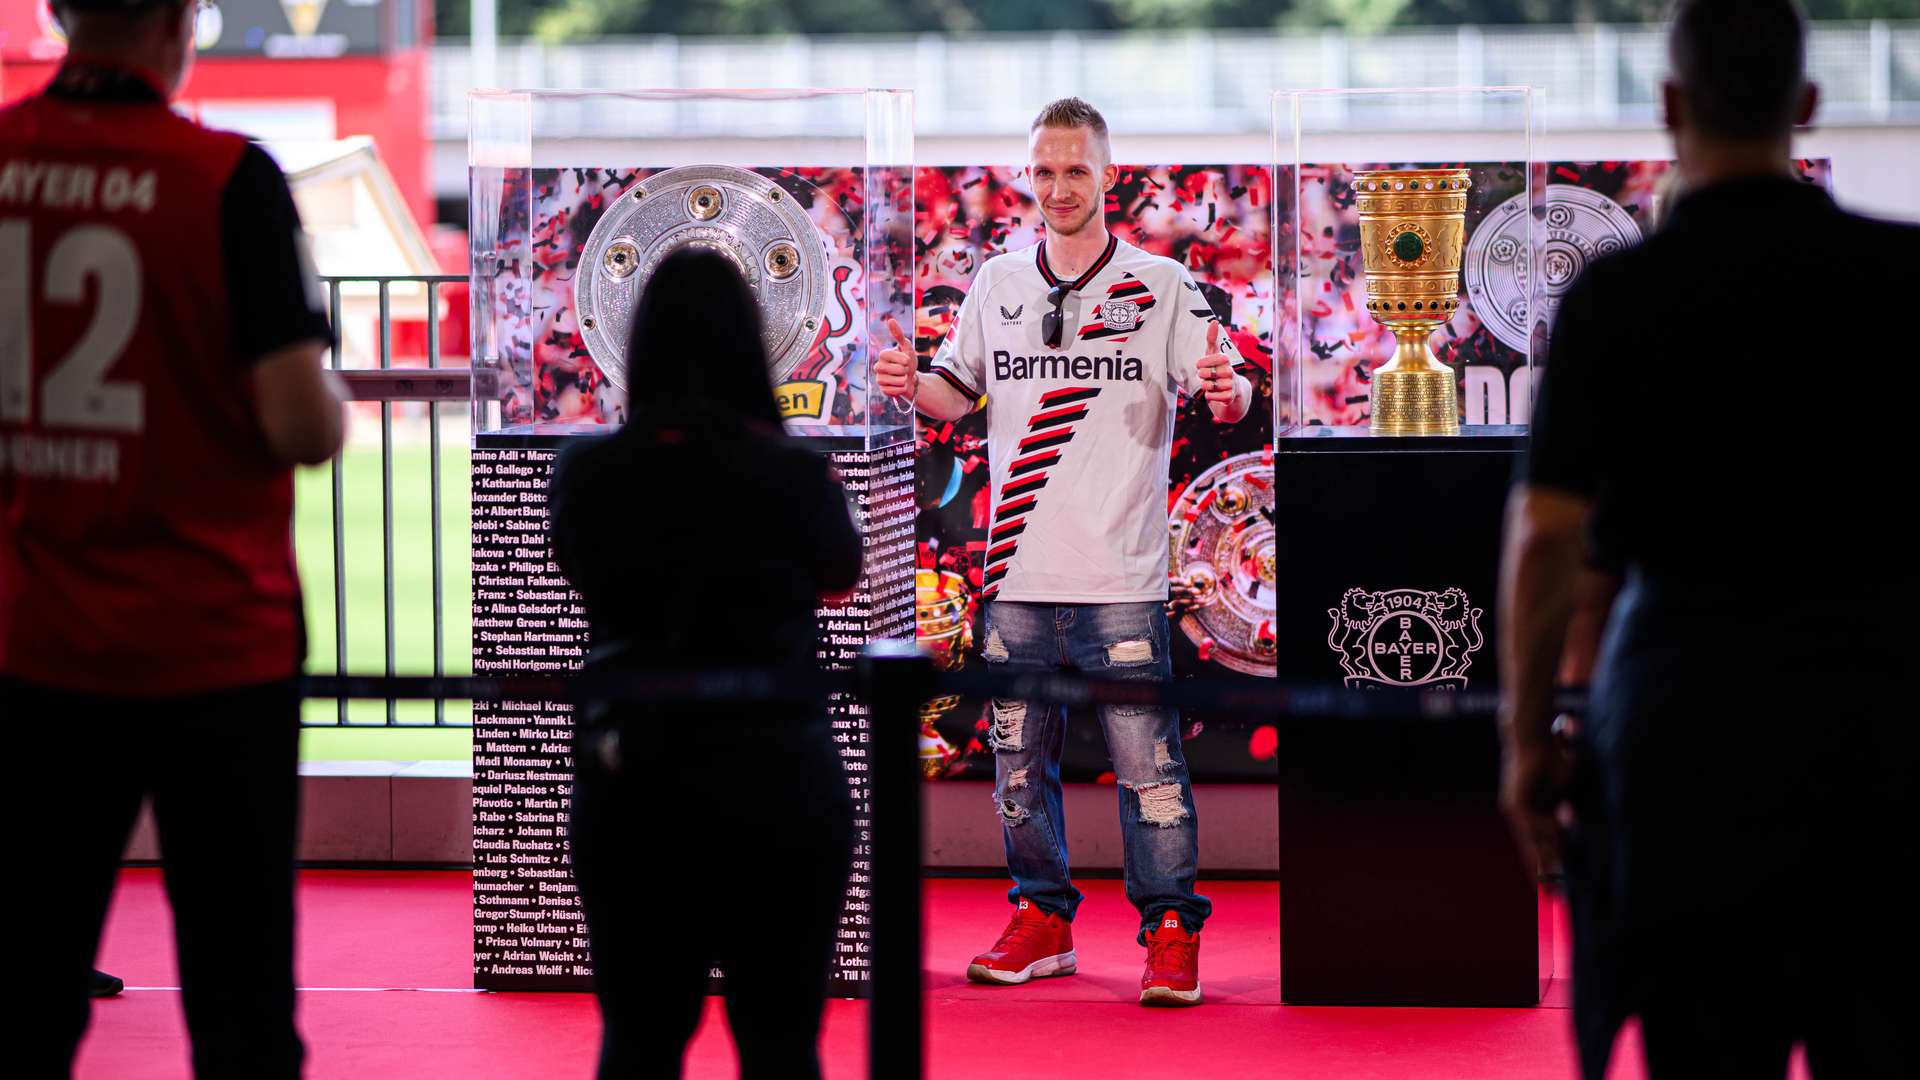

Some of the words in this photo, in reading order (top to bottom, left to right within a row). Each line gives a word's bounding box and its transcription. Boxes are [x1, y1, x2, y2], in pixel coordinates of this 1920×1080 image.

[101, 163, 158, 213] 04
[993, 349, 1143, 382] Barmenia
[472, 451, 497, 460] mine
[498, 451, 518, 460] Adli
[496, 464, 533, 476] Gallego
[481, 478, 531, 488] Katharina
[841, 481, 869, 490] obel
[490, 506, 522, 516] Albert
[505, 520, 541, 530] Sabine
[491, 534, 519, 544] Petra
[521, 534, 544, 544] Dahl
[514, 548, 545, 558] Oliver
[509, 562, 544, 573] Philipp
[478, 576, 524, 585] Christian
[478, 590, 506, 599] Franz
[516, 590, 567, 600] Sebastian
[1387, 595, 1422, 609] 1904
[491, 604, 517, 613] Alina
[518, 604, 561, 613] Gelsdorf
[516, 618, 547, 627] Green
[826, 621, 861, 630] Adrian
[480, 631, 522, 643] Stephan
[524, 632, 574, 641] Hartmann
[830, 634, 864, 645] Tobias
[495, 645, 546, 655] Sebastian
[549, 646, 582, 656] Hirsch
[1374, 642, 1437, 655] BAYER
[1398, 617, 1412, 680] BAYER
[474, 659, 511, 670] Kiyoshi
[512, 659, 561, 671] Horigome
[502, 701, 541, 710] Michael
[474, 715, 526, 724] Lackmann
[533, 715, 566, 725] Yannik
[476, 728, 510, 738] Linden
[519, 729, 549, 738] Mirko
[486, 742, 526, 752] Mattern
[838, 747, 866, 756] shua
[475, 756, 501, 766] Madi
[503, 757, 552, 768] Monamay
[487, 770, 526, 780] Dariusz
[504, 784, 547, 794] Palacios
[473, 798, 513, 807] Plavotic
[524, 799, 558, 808] Martin
[479, 812, 506, 821] Rabe
[515, 812, 555, 822] Sabrina
[517, 826, 553, 836] Johann
[472, 839, 510, 849] Claudia
[512, 840, 553, 849] Ruchatz
[486, 853, 507, 863] Luis
[510, 854, 551, 863] Schmitz
[517, 868, 568, 877] Sebastian
[479, 895, 529, 905] Sothmann
[538, 896, 573, 905] Denise
[474, 909, 509, 920] Gregor
[509, 909, 546, 920] Stumpf
[506, 923, 535, 932] Heike
[536, 924, 567, 933] Urban
[485, 937, 518, 946] Prisca
[520, 937, 562, 949] Volmary
[502, 951, 536, 960] Adrian
[539, 951, 574, 961] Weicht
[491, 964, 533, 974] Andreas
[536, 965, 563, 975] Wolff
[842, 970, 858, 980] Till
